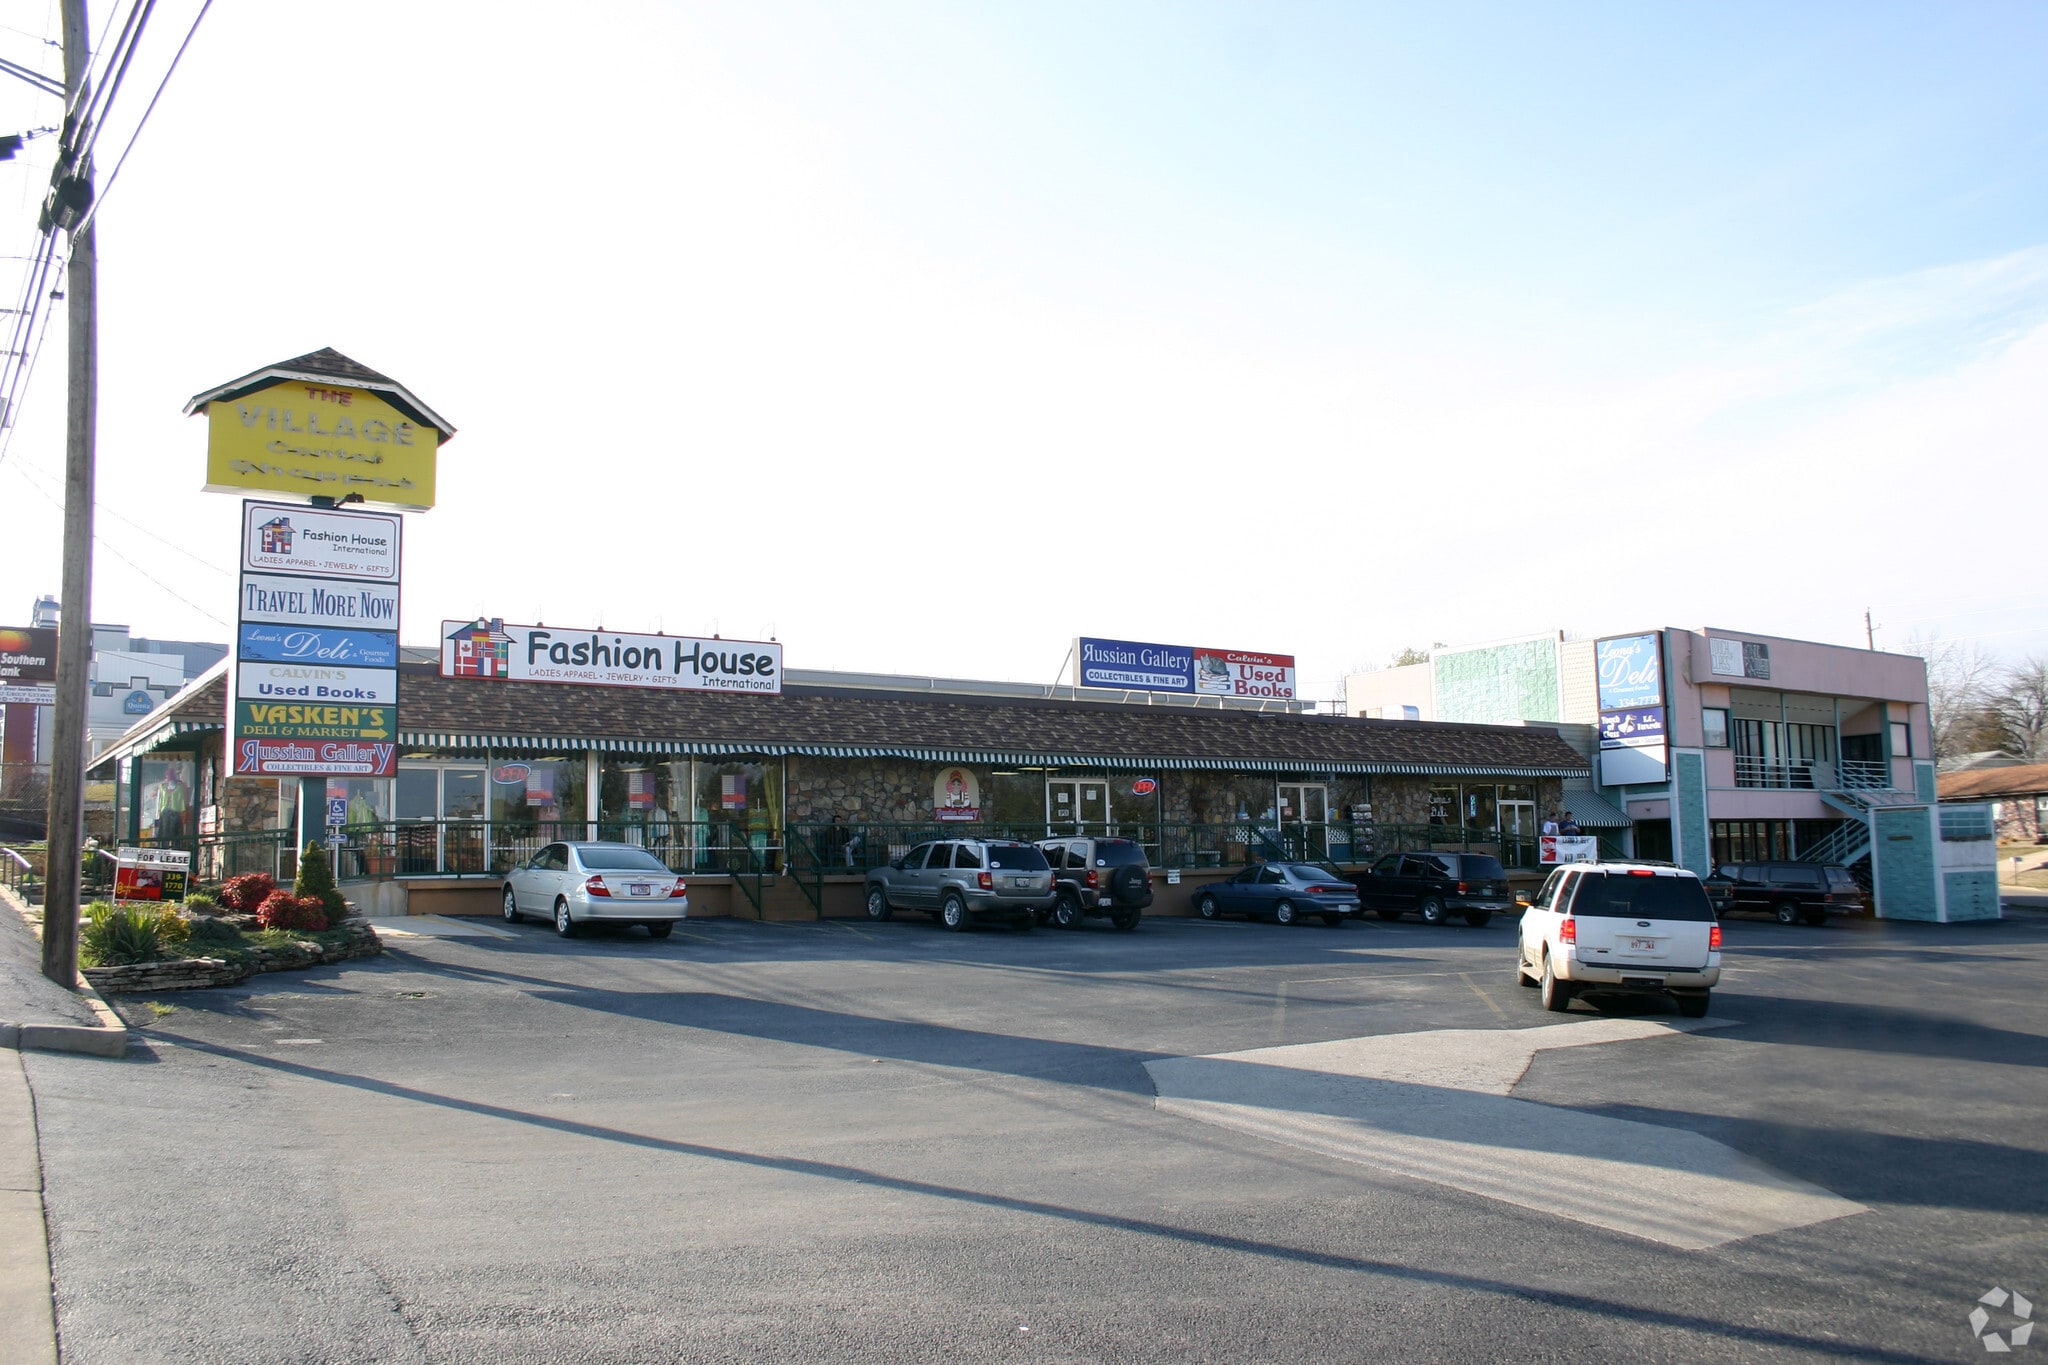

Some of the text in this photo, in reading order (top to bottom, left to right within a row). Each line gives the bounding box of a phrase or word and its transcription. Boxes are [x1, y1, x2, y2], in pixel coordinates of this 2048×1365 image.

[305, 387, 352, 406] THE
[234, 403, 416, 446] VILLAGE
[303, 529, 387, 546] Fashion House
[332, 544, 388, 556] International
[254, 556, 390, 573] LADIES APPAREL JEWELRY GIFTS
[246, 584, 394, 620] TRAVEL MORE NOW
[247, 629, 282, 642] Leona's
[282, 632, 354, 660] Deli
[360, 649, 390, 657] Gourmet
[1, 652, 46, 666] Southern
[528, 632, 774, 676] Fashion House
[1140, 648, 1190, 673] Gallery
[1227, 653, 1272, 664] Calvin's
[0, 665, 21, 677] ank
[270, 667, 346, 680] CALVIN'S
[528, 668, 678, 684] LADIES APPAREL JEWELRY GIFTS
[1088, 670, 1144, 682] COLLECTIBLES
[1153, 676, 1170, 684] FINE
[1172, 678, 1186, 686] ART
[1239, 665, 1286, 683] Used
[1600, 656, 1658, 688] Deli
[702, 676, 775, 690] International
[1234, 680, 1292, 698] Books
[259, 684, 376, 699] Used Books
[250, 704, 384, 726] VASKEN'S
[243, 726, 358, 738] DELI & MARKET
[266, 763, 368, 772] COLLECTIBLES & FINE ART
[492, 766, 528, 781] OPEN
[1134, 782, 1153, 793] OPEN
[138, 854, 188, 864] FOR LEASE
[165, 882, 183, 890] 1770
